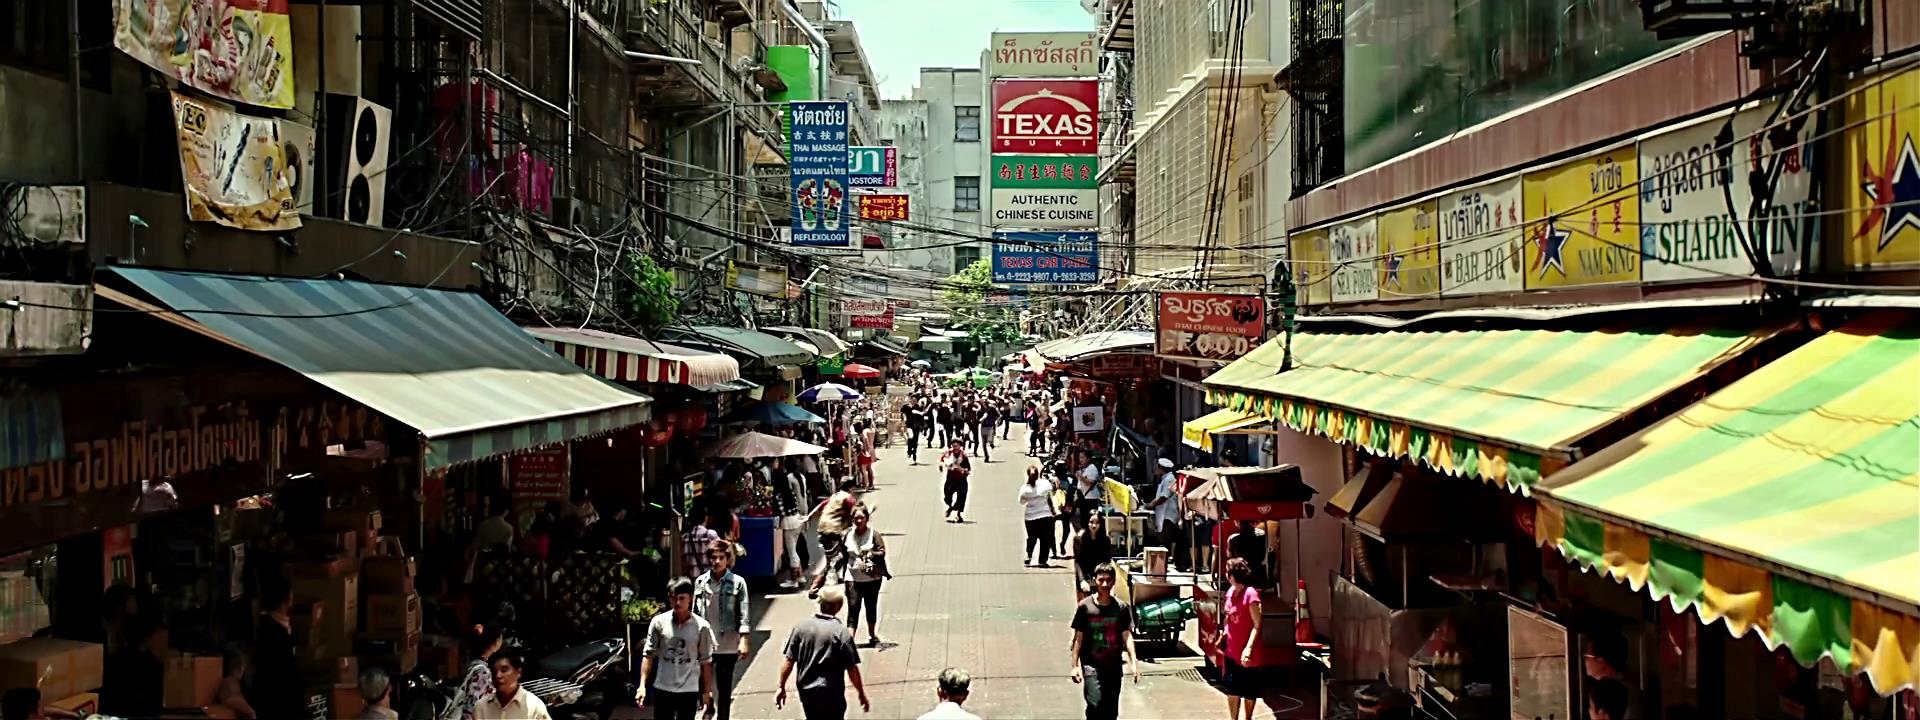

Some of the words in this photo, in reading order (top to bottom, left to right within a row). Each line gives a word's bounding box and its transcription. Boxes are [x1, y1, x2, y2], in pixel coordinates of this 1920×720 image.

[996, 33, 1097, 71] เท็กซัสสุกี้
[792, 105, 845, 126] หัตถชัย
[997, 114, 1093, 135] TEXAS
[811, 144, 847, 152] MASSAGE
[1003, 139, 1087, 147] SUKI
[793, 164, 847, 176] นวดแผนไทย
[848, 176, 884, 185] UGSTORE
[1011, 195, 1078, 205] AUTHENTIC
[996, 210, 1046, 220] CHINESE
[1048, 210, 1094, 220] CUISINE
[794, 233, 847, 241] REFLEXOLOGY
[1659, 213, 1739, 265] SHARK
[1001, 256, 1033, 269] TEXAS
[1037, 256, 1059, 269] CAR
[1606, 243, 1635, 274] SING
[1455, 251, 1479, 283] BAR
